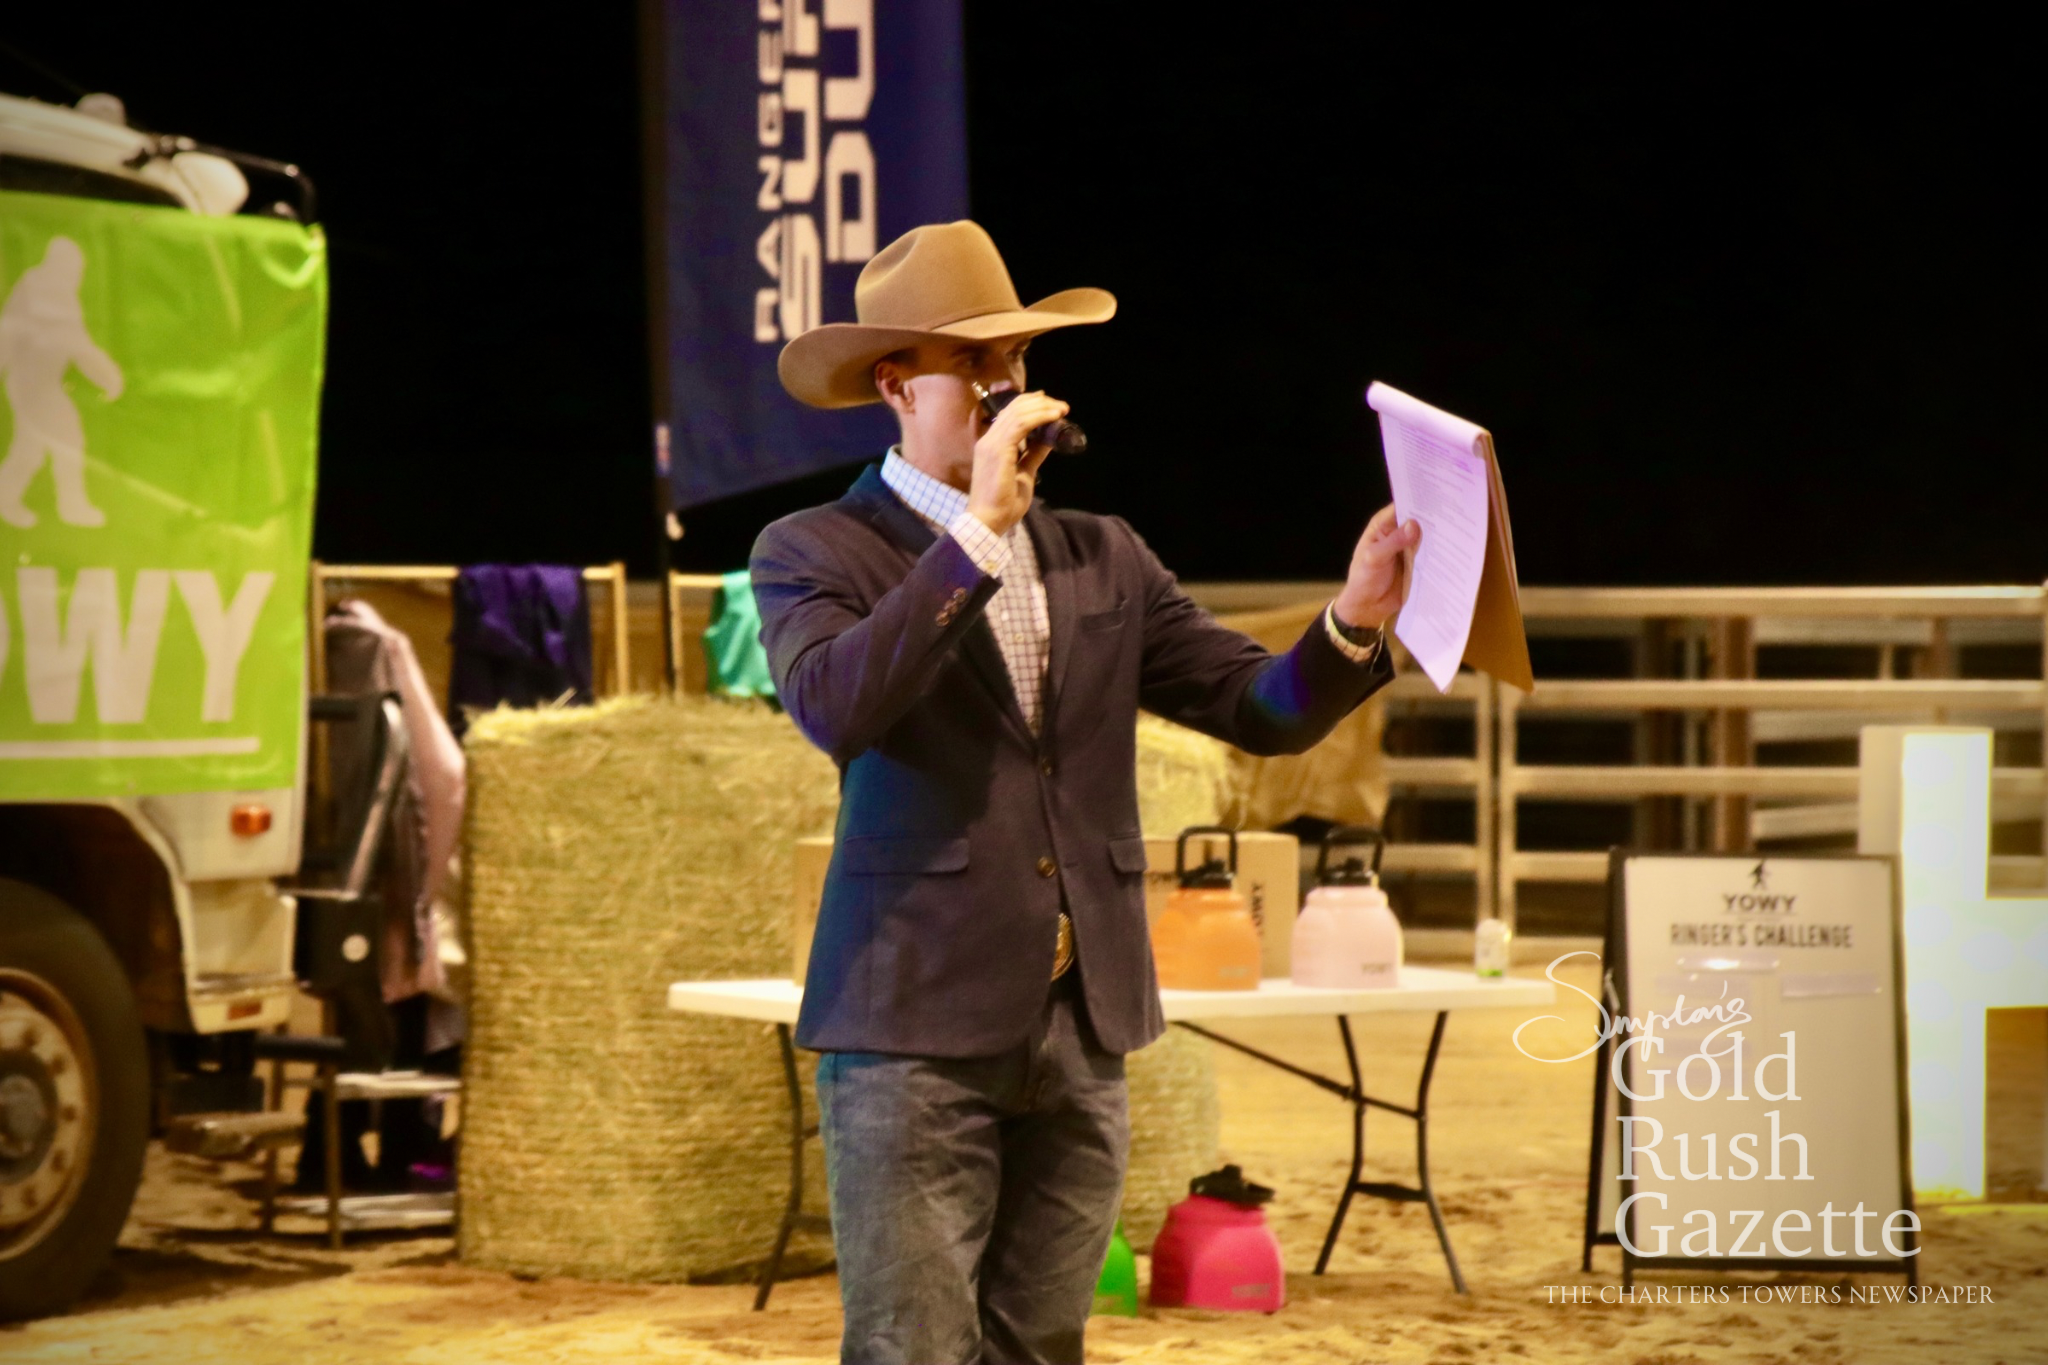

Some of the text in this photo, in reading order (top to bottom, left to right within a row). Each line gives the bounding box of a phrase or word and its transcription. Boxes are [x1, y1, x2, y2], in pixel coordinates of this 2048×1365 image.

[0, 566, 276, 724] WY
[1723, 893, 1797, 913] YOWY
[1669, 923, 1853, 948] RINGER'S CHALLENGE
